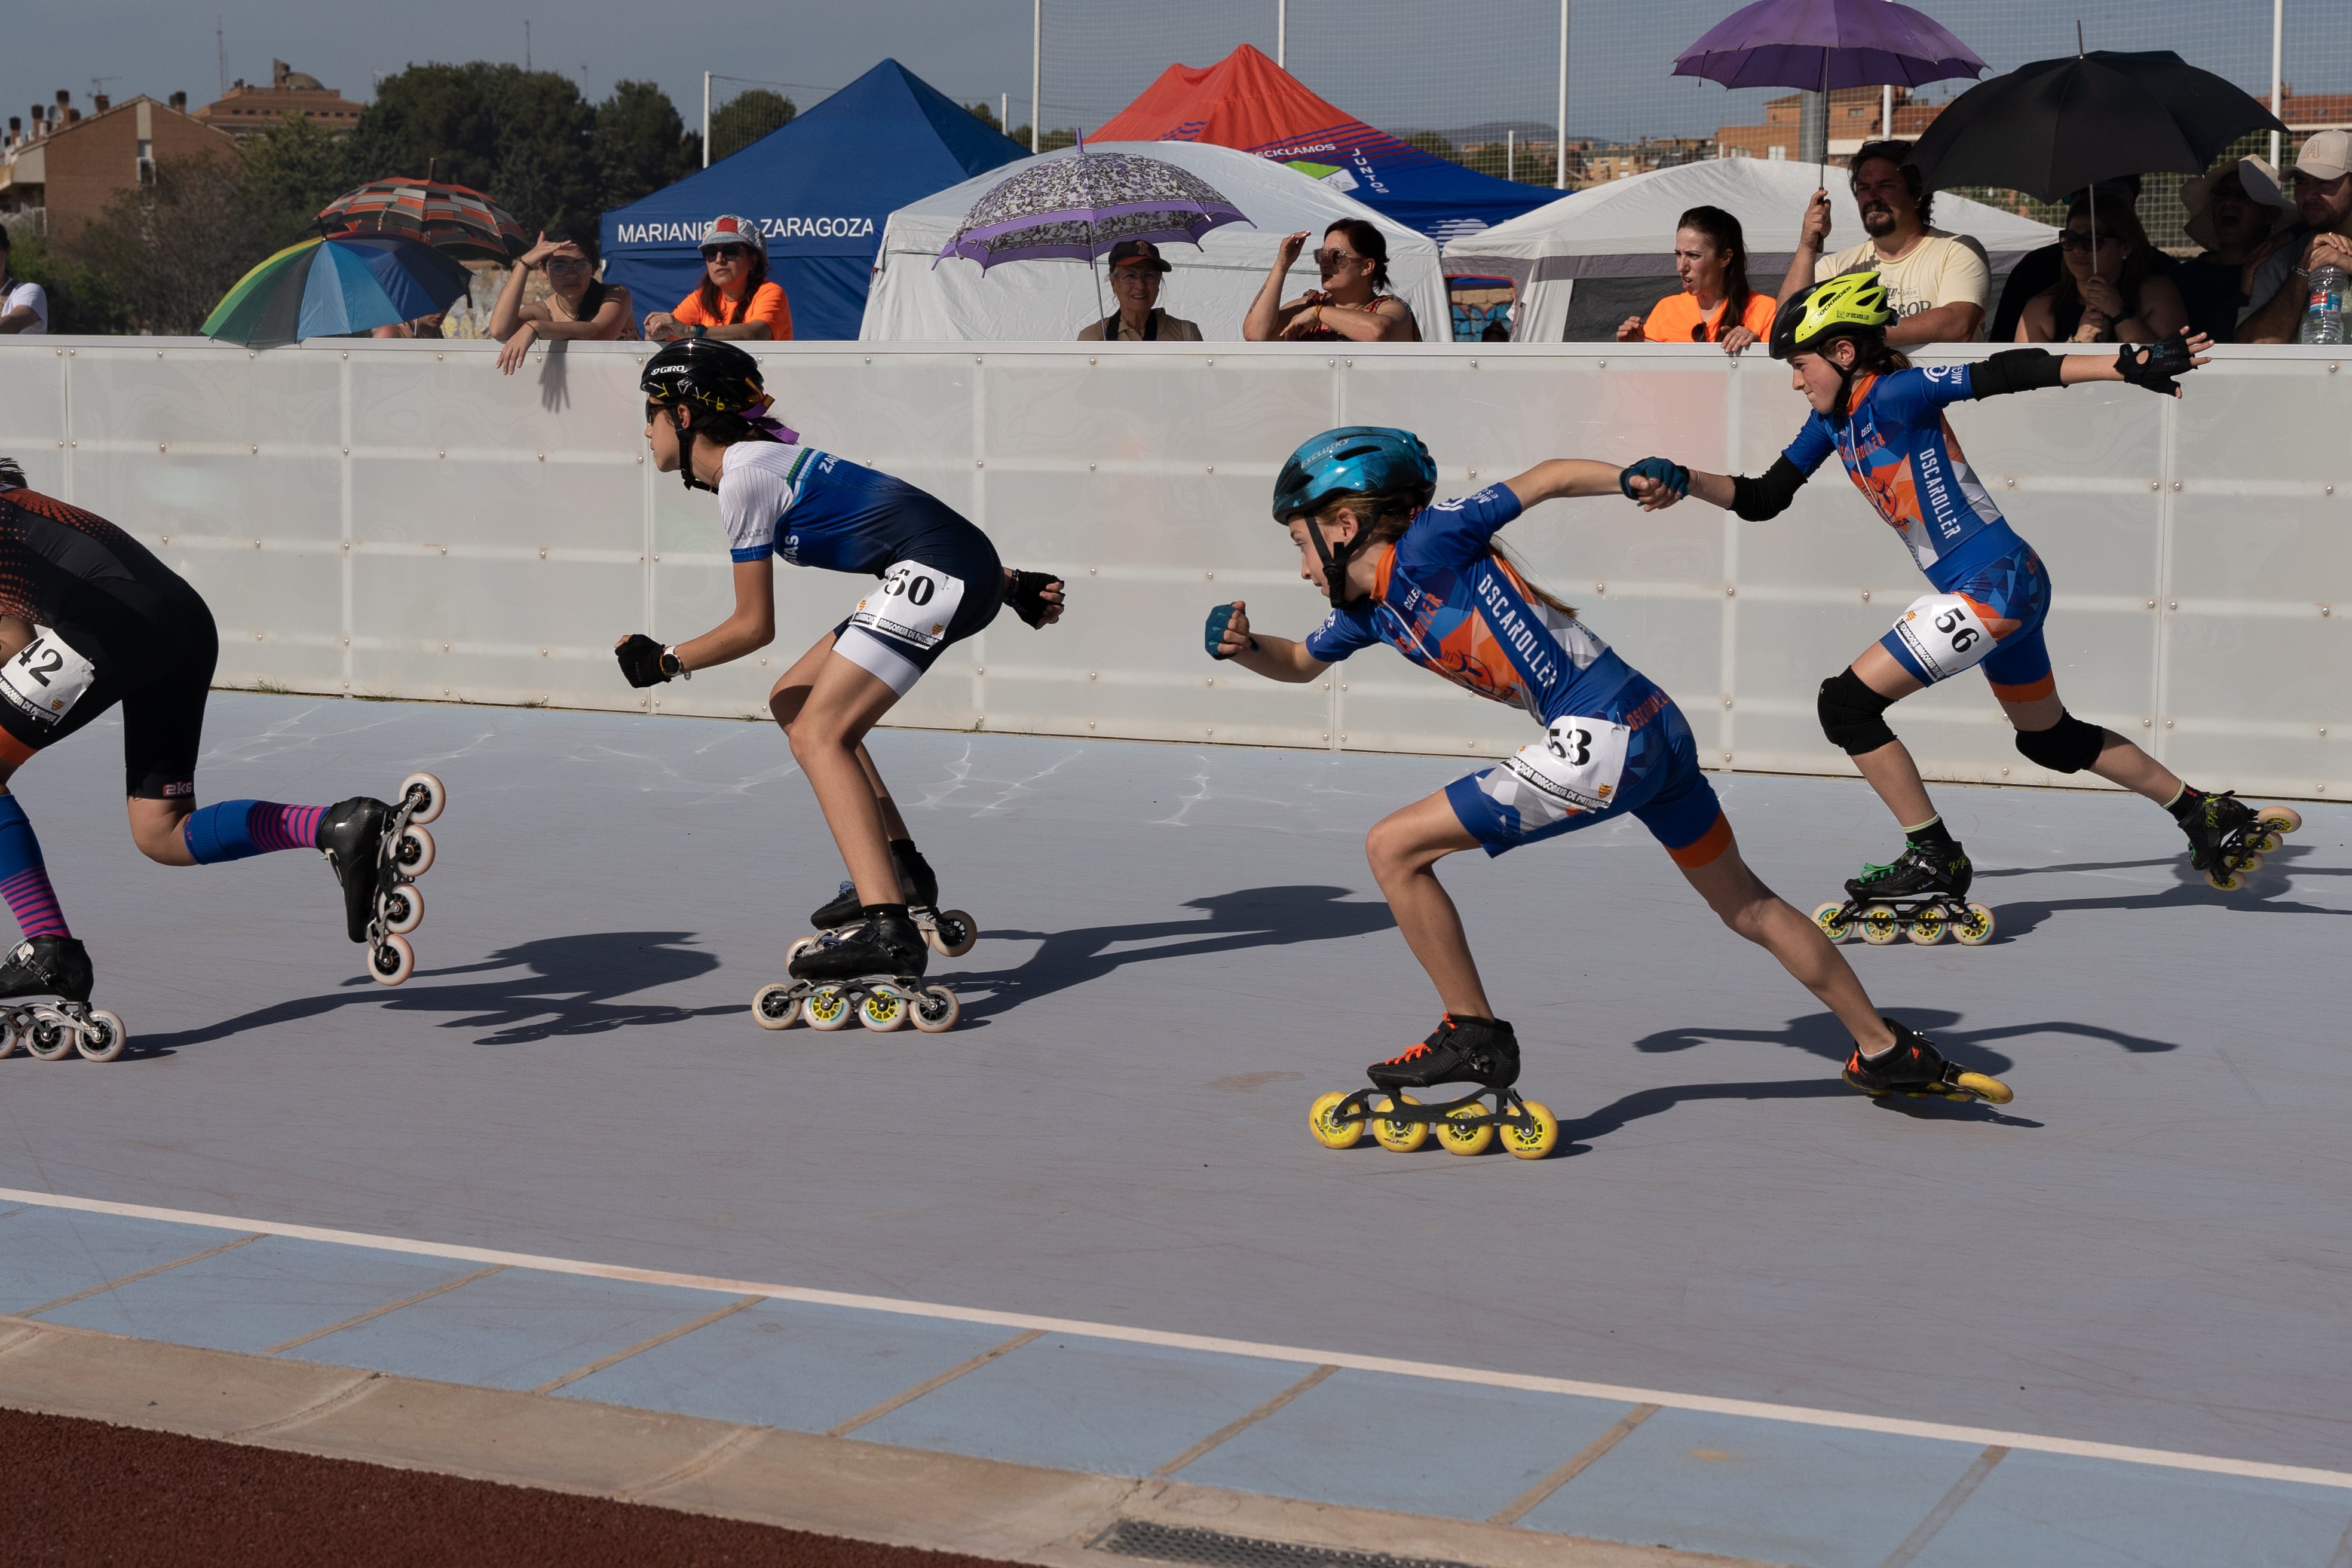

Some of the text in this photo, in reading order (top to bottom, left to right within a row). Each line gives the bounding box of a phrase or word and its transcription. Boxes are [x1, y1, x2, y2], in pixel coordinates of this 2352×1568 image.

[1255, 144, 1336, 158] ECICLAMOS
[760, 216, 874, 238] ZARAGOZA
[1816, 286, 1852, 320] ROCKRIDER
[660, 365, 685, 373] GIRO
[1301, 438, 1349, 469] EXCLUSKY
[1919, 448, 1961, 539] OSCAROLLER
[884, 569, 935, 606] 50
[1478, 574, 1558, 688] OSCAROLLER
[1935, 607, 1979, 653] 56
[18, 638, 63, 687] 42
[22, 702, 32, 711] DE
[1549, 728, 1592, 766] 53
[1531, 770, 1568, 797] ARAGONESA
[1567, 791, 1577, 801] DE
